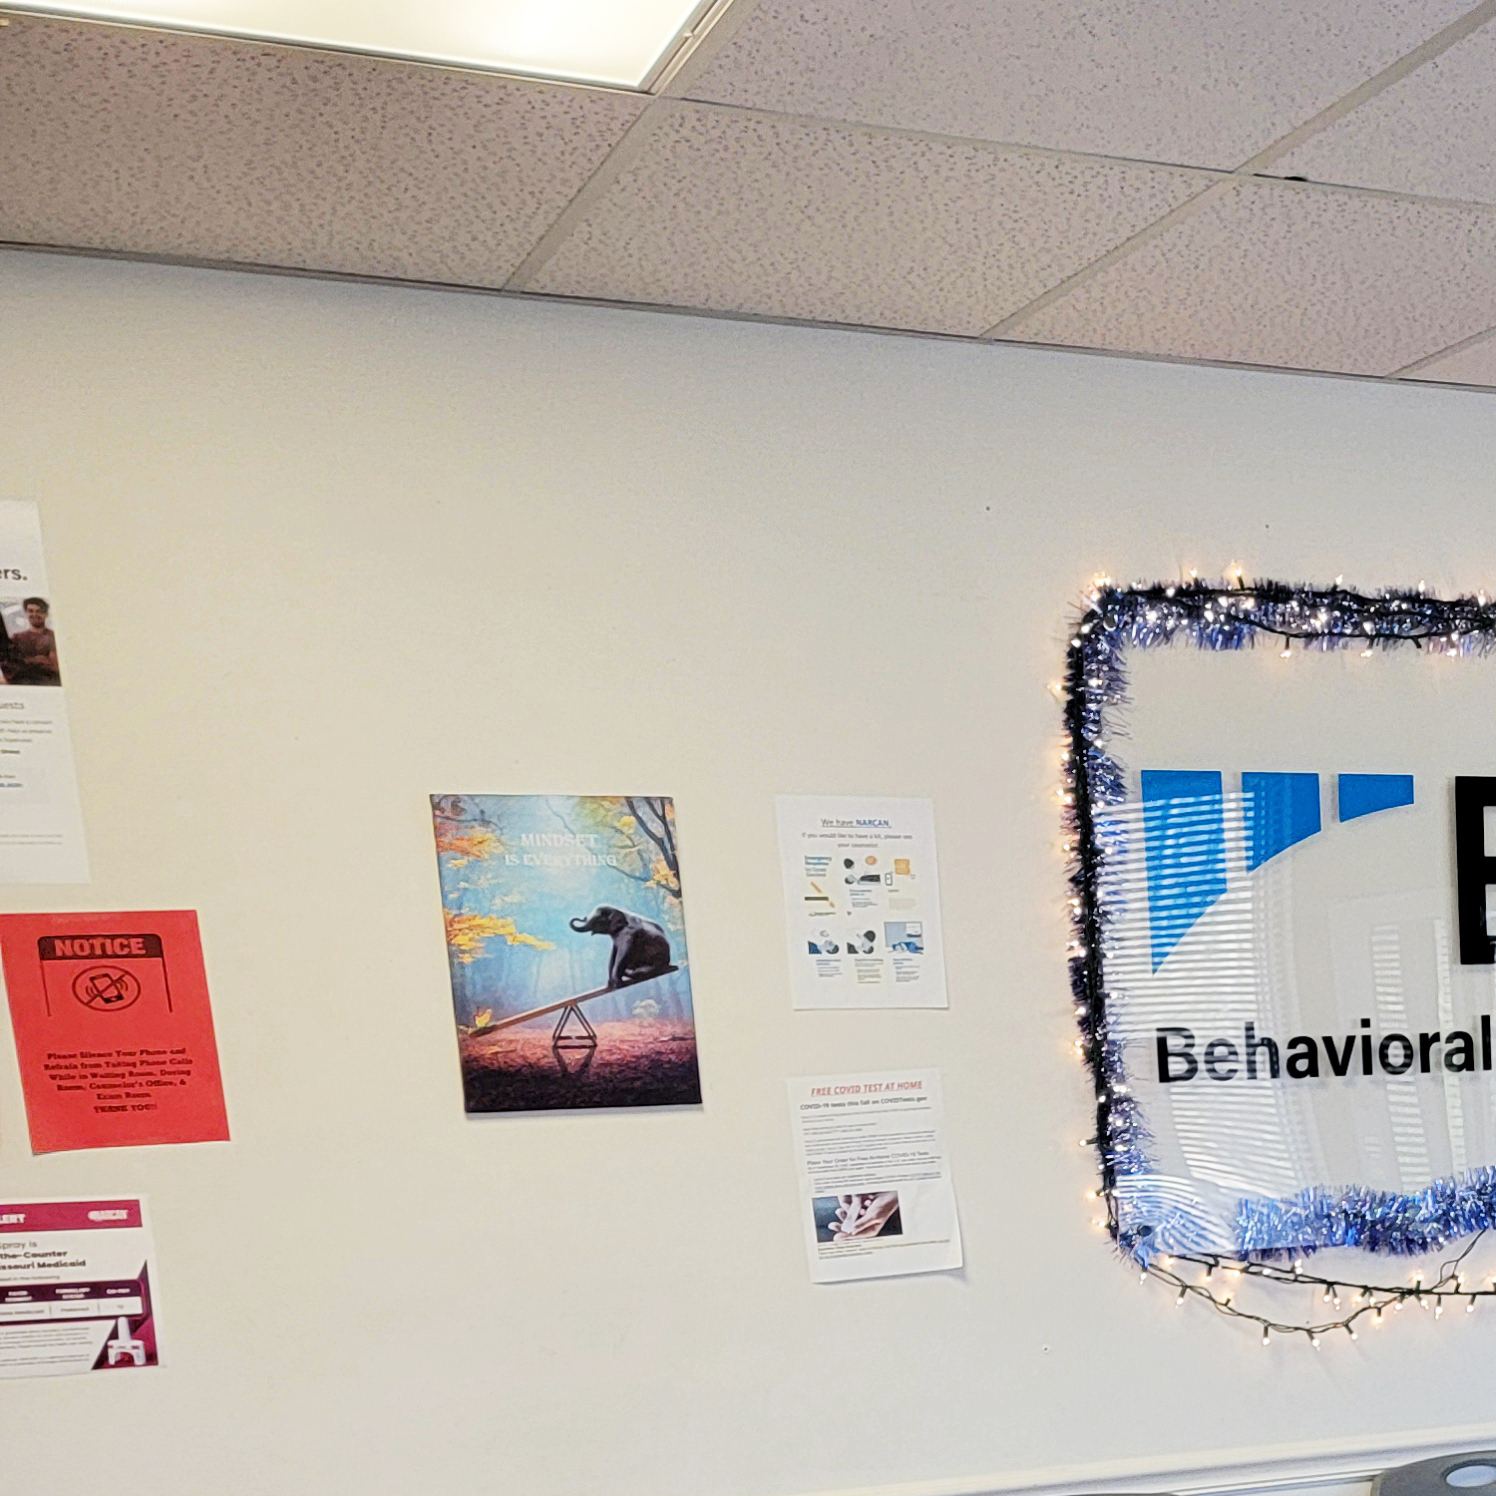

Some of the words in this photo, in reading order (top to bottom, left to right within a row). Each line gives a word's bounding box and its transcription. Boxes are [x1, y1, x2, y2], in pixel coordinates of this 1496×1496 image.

[520, 833, 598, 847] MINDSET
[504, 854, 519, 866] IS
[522, 853, 618, 867] EVERYTHING
[54, 937, 147, 956] NOTICE
[1156, 1015, 1492, 1083] Behavioral
[811, 1087, 832, 1097] FREE
[834, 1085, 861, 1095] COVID
[864, 1083, 883, 1093] TEST
[884, 1082, 895, 1091] AT
[897, 1081, 922, 1090] HOME
[0, 1241, 26, 1250] pray
[29, 1240, 38, 1248] is
[37, 1259, 86, 1268] Medicaid
